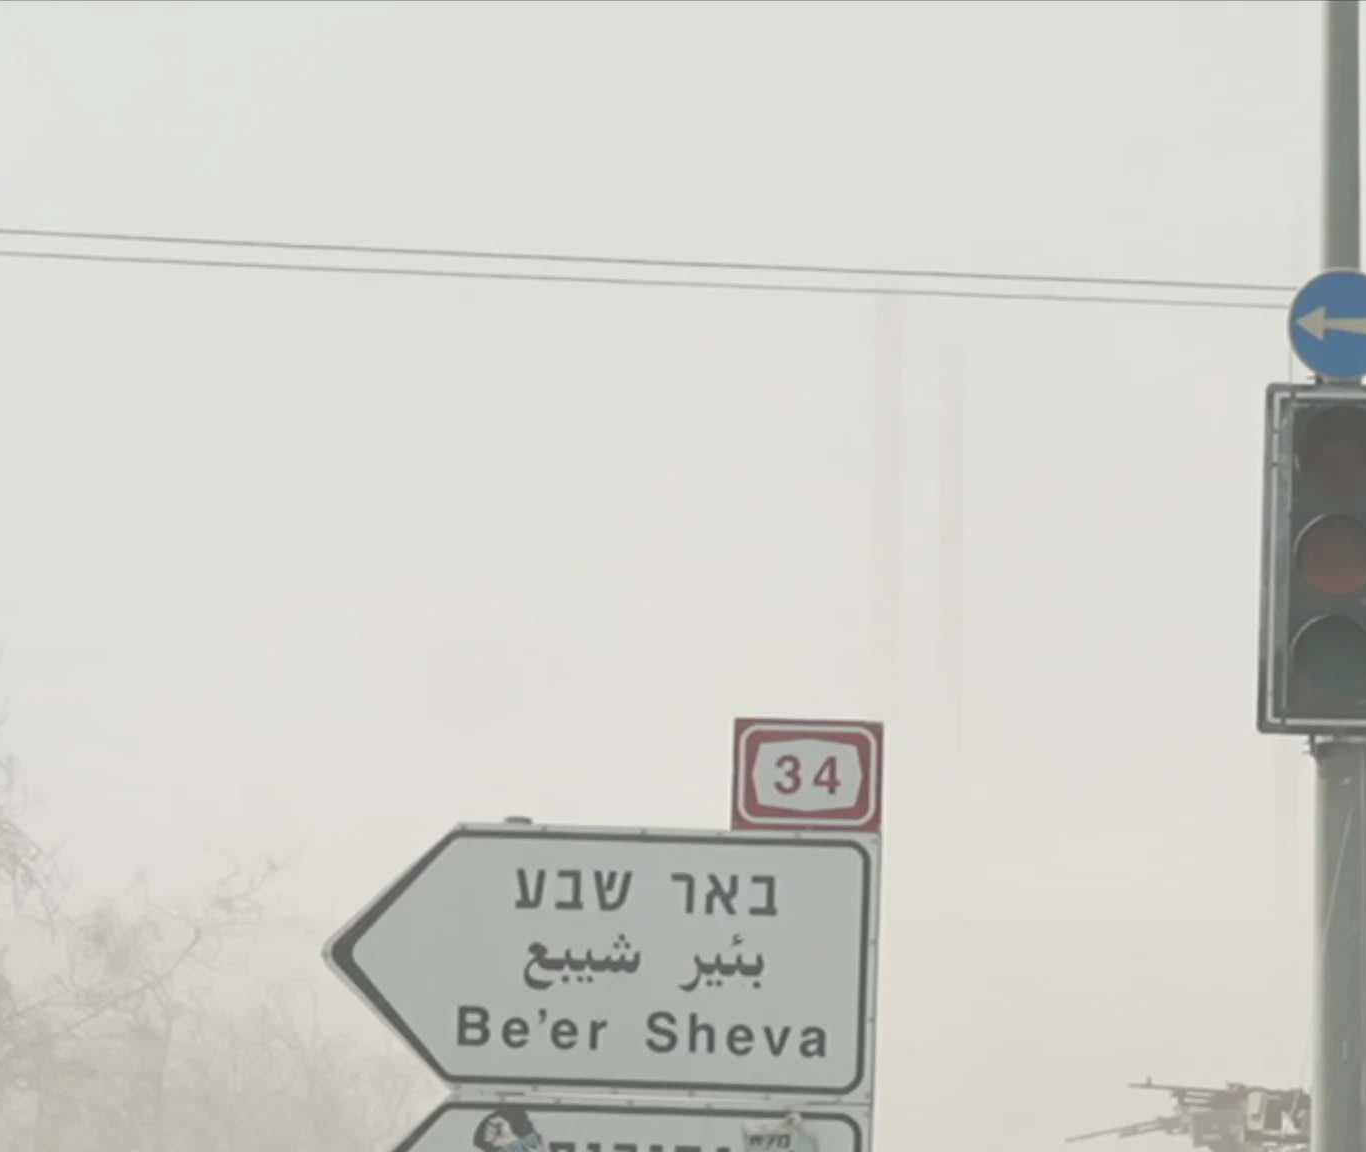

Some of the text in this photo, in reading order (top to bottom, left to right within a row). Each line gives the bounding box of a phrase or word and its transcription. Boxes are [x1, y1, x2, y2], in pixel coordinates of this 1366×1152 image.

[774, 754, 841, 796] 34
[515, 868, 778, 917] באר שבע
[523, 933, 765, 993] بئير شيبع
[645, 1010, 826, 1058] Sheva
